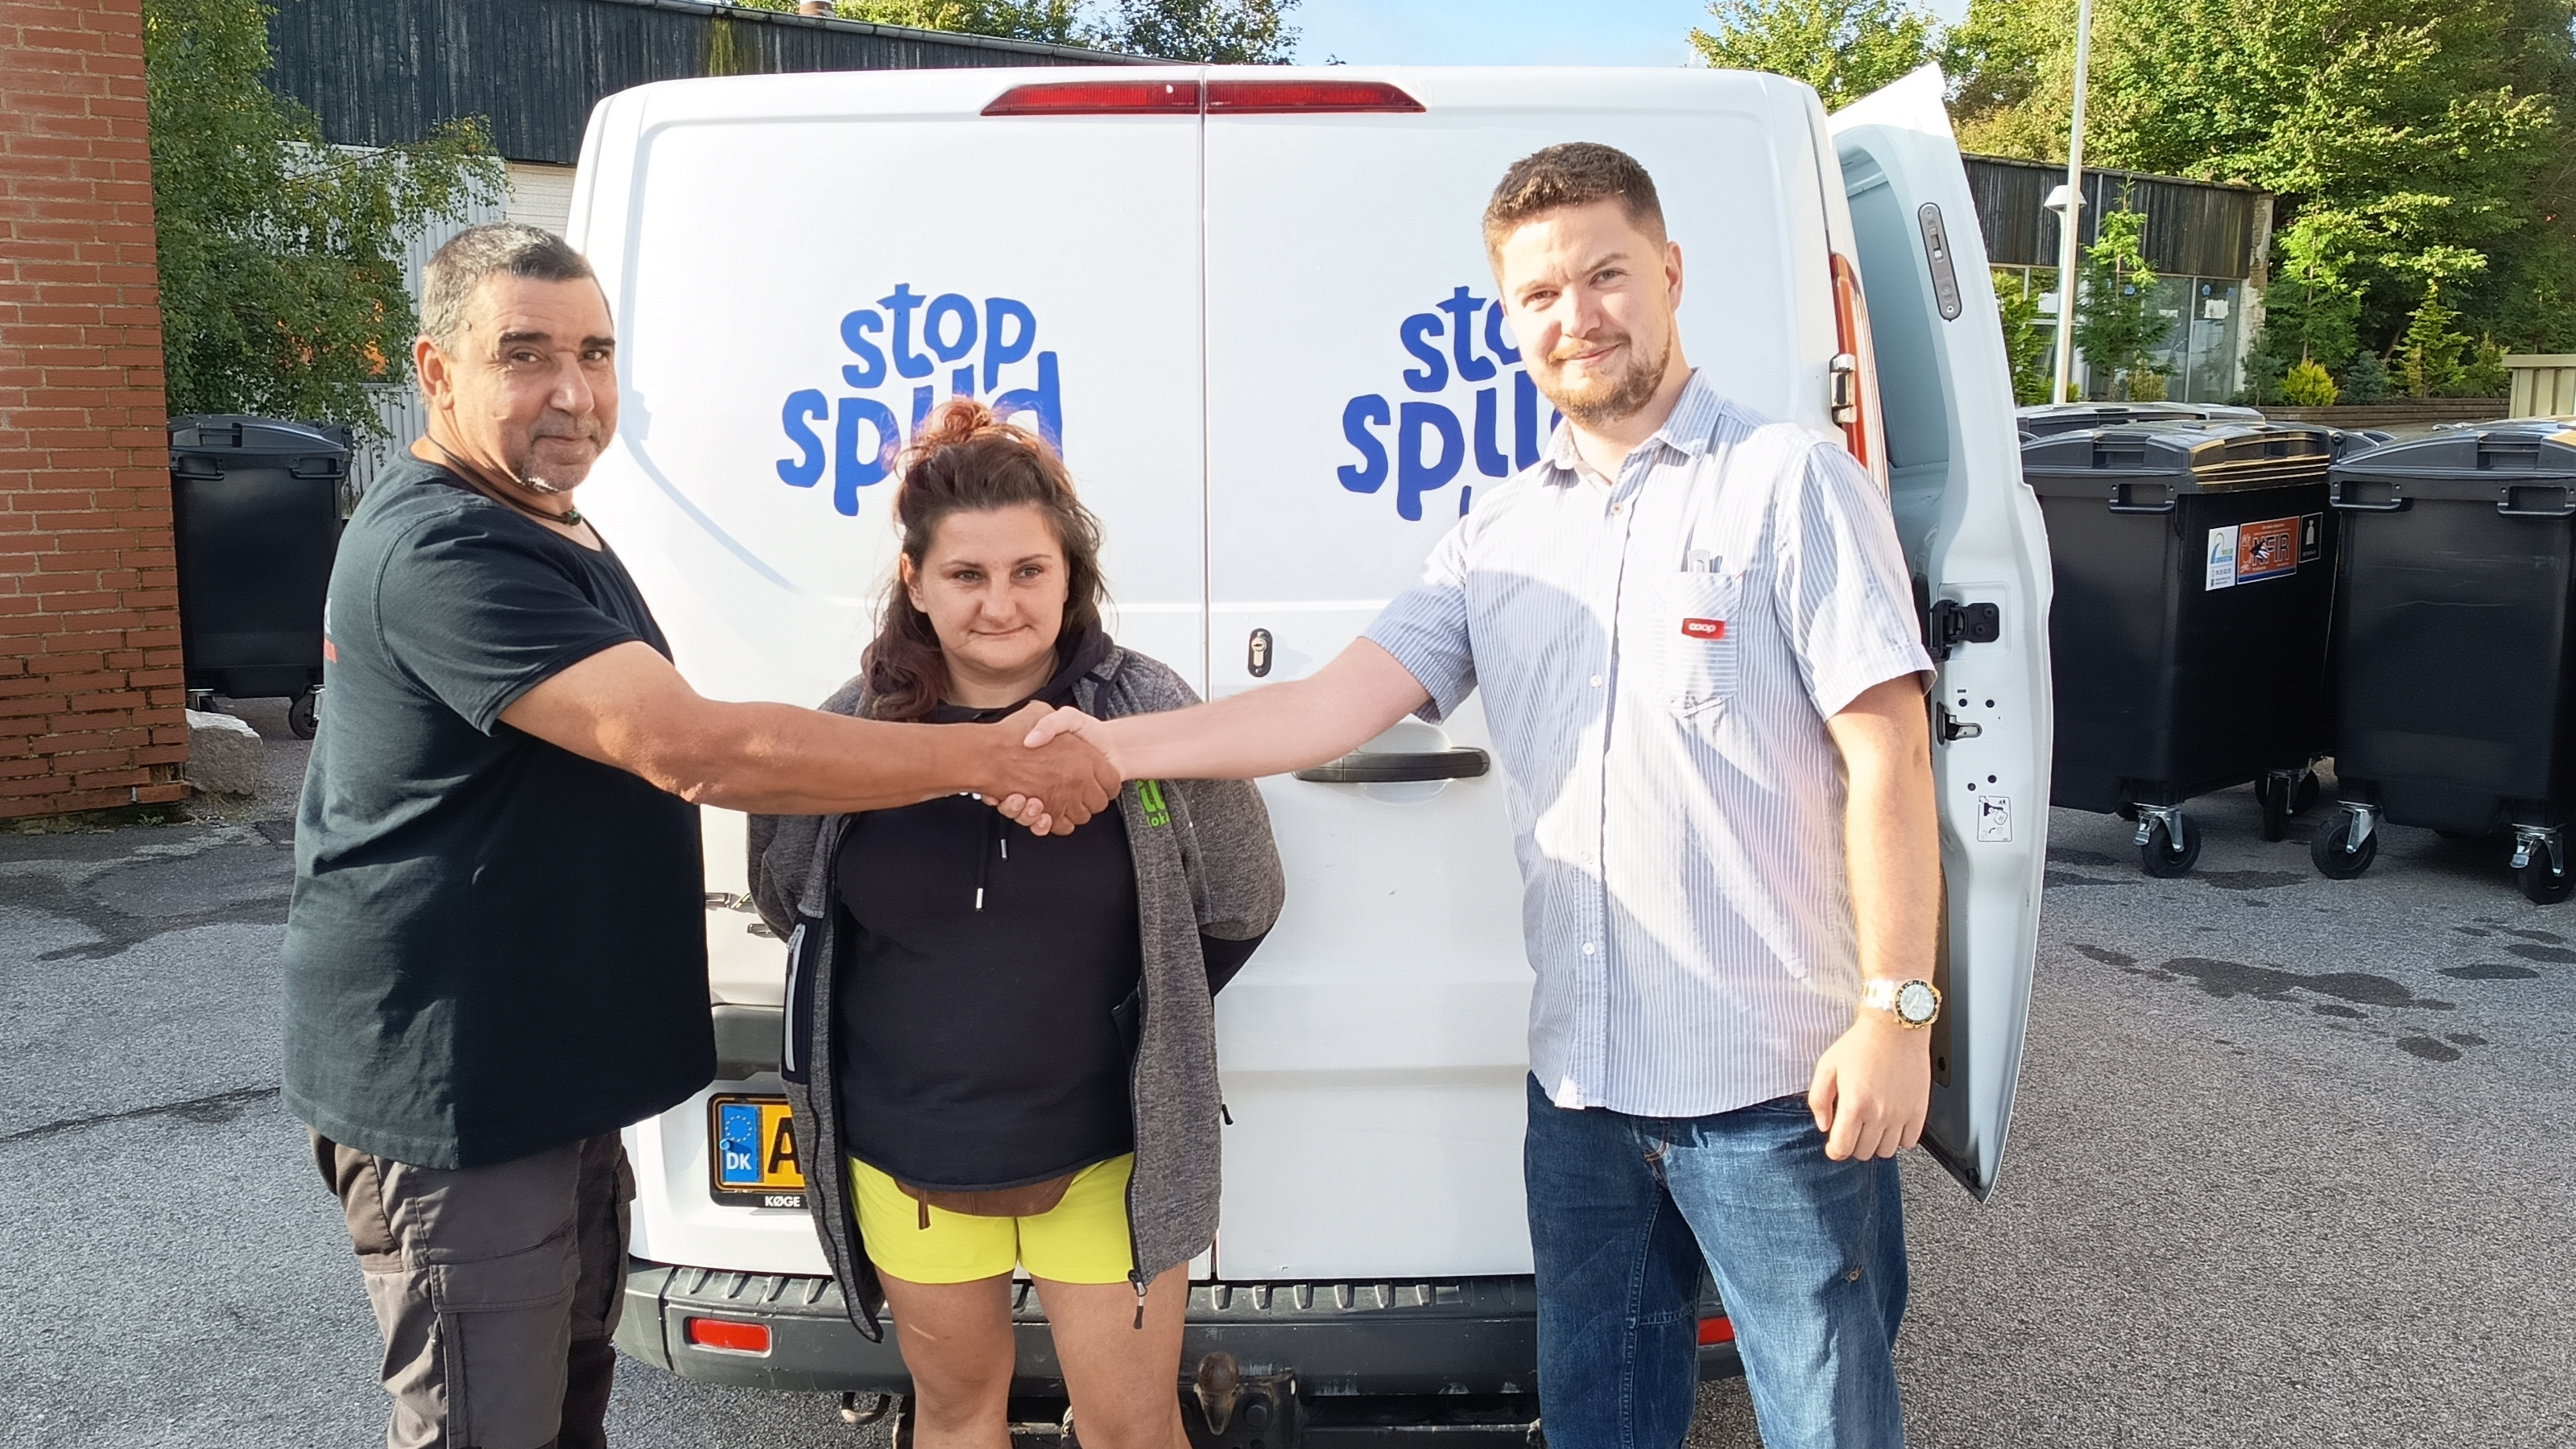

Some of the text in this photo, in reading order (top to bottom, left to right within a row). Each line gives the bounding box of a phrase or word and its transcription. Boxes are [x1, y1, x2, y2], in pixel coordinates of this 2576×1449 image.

[840, 283, 1036, 394] stop
[1400, 286, 1524, 393] sto
[1337, 369, 1562, 522] spil
[726, 1152, 752, 1170] DK
[764, 1195, 801, 1208] KØGE
